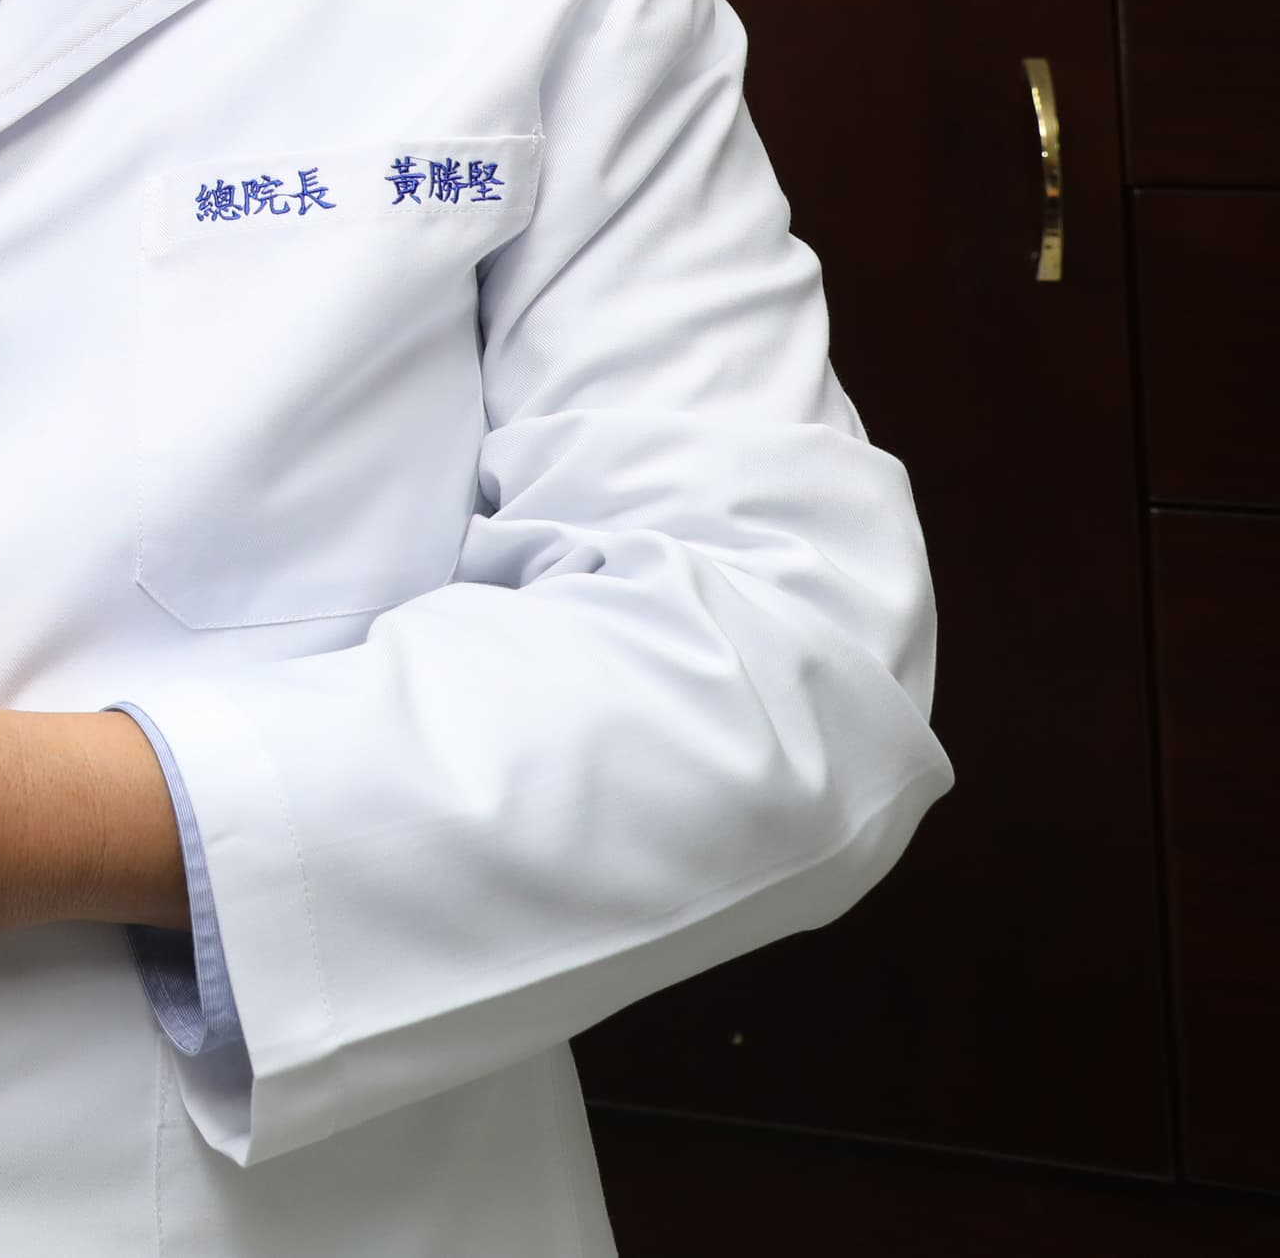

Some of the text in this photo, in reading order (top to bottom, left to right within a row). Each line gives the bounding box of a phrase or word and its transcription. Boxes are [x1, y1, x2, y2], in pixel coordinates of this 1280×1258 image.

[195, 154, 506, 223] 總院長 黃勝堅
